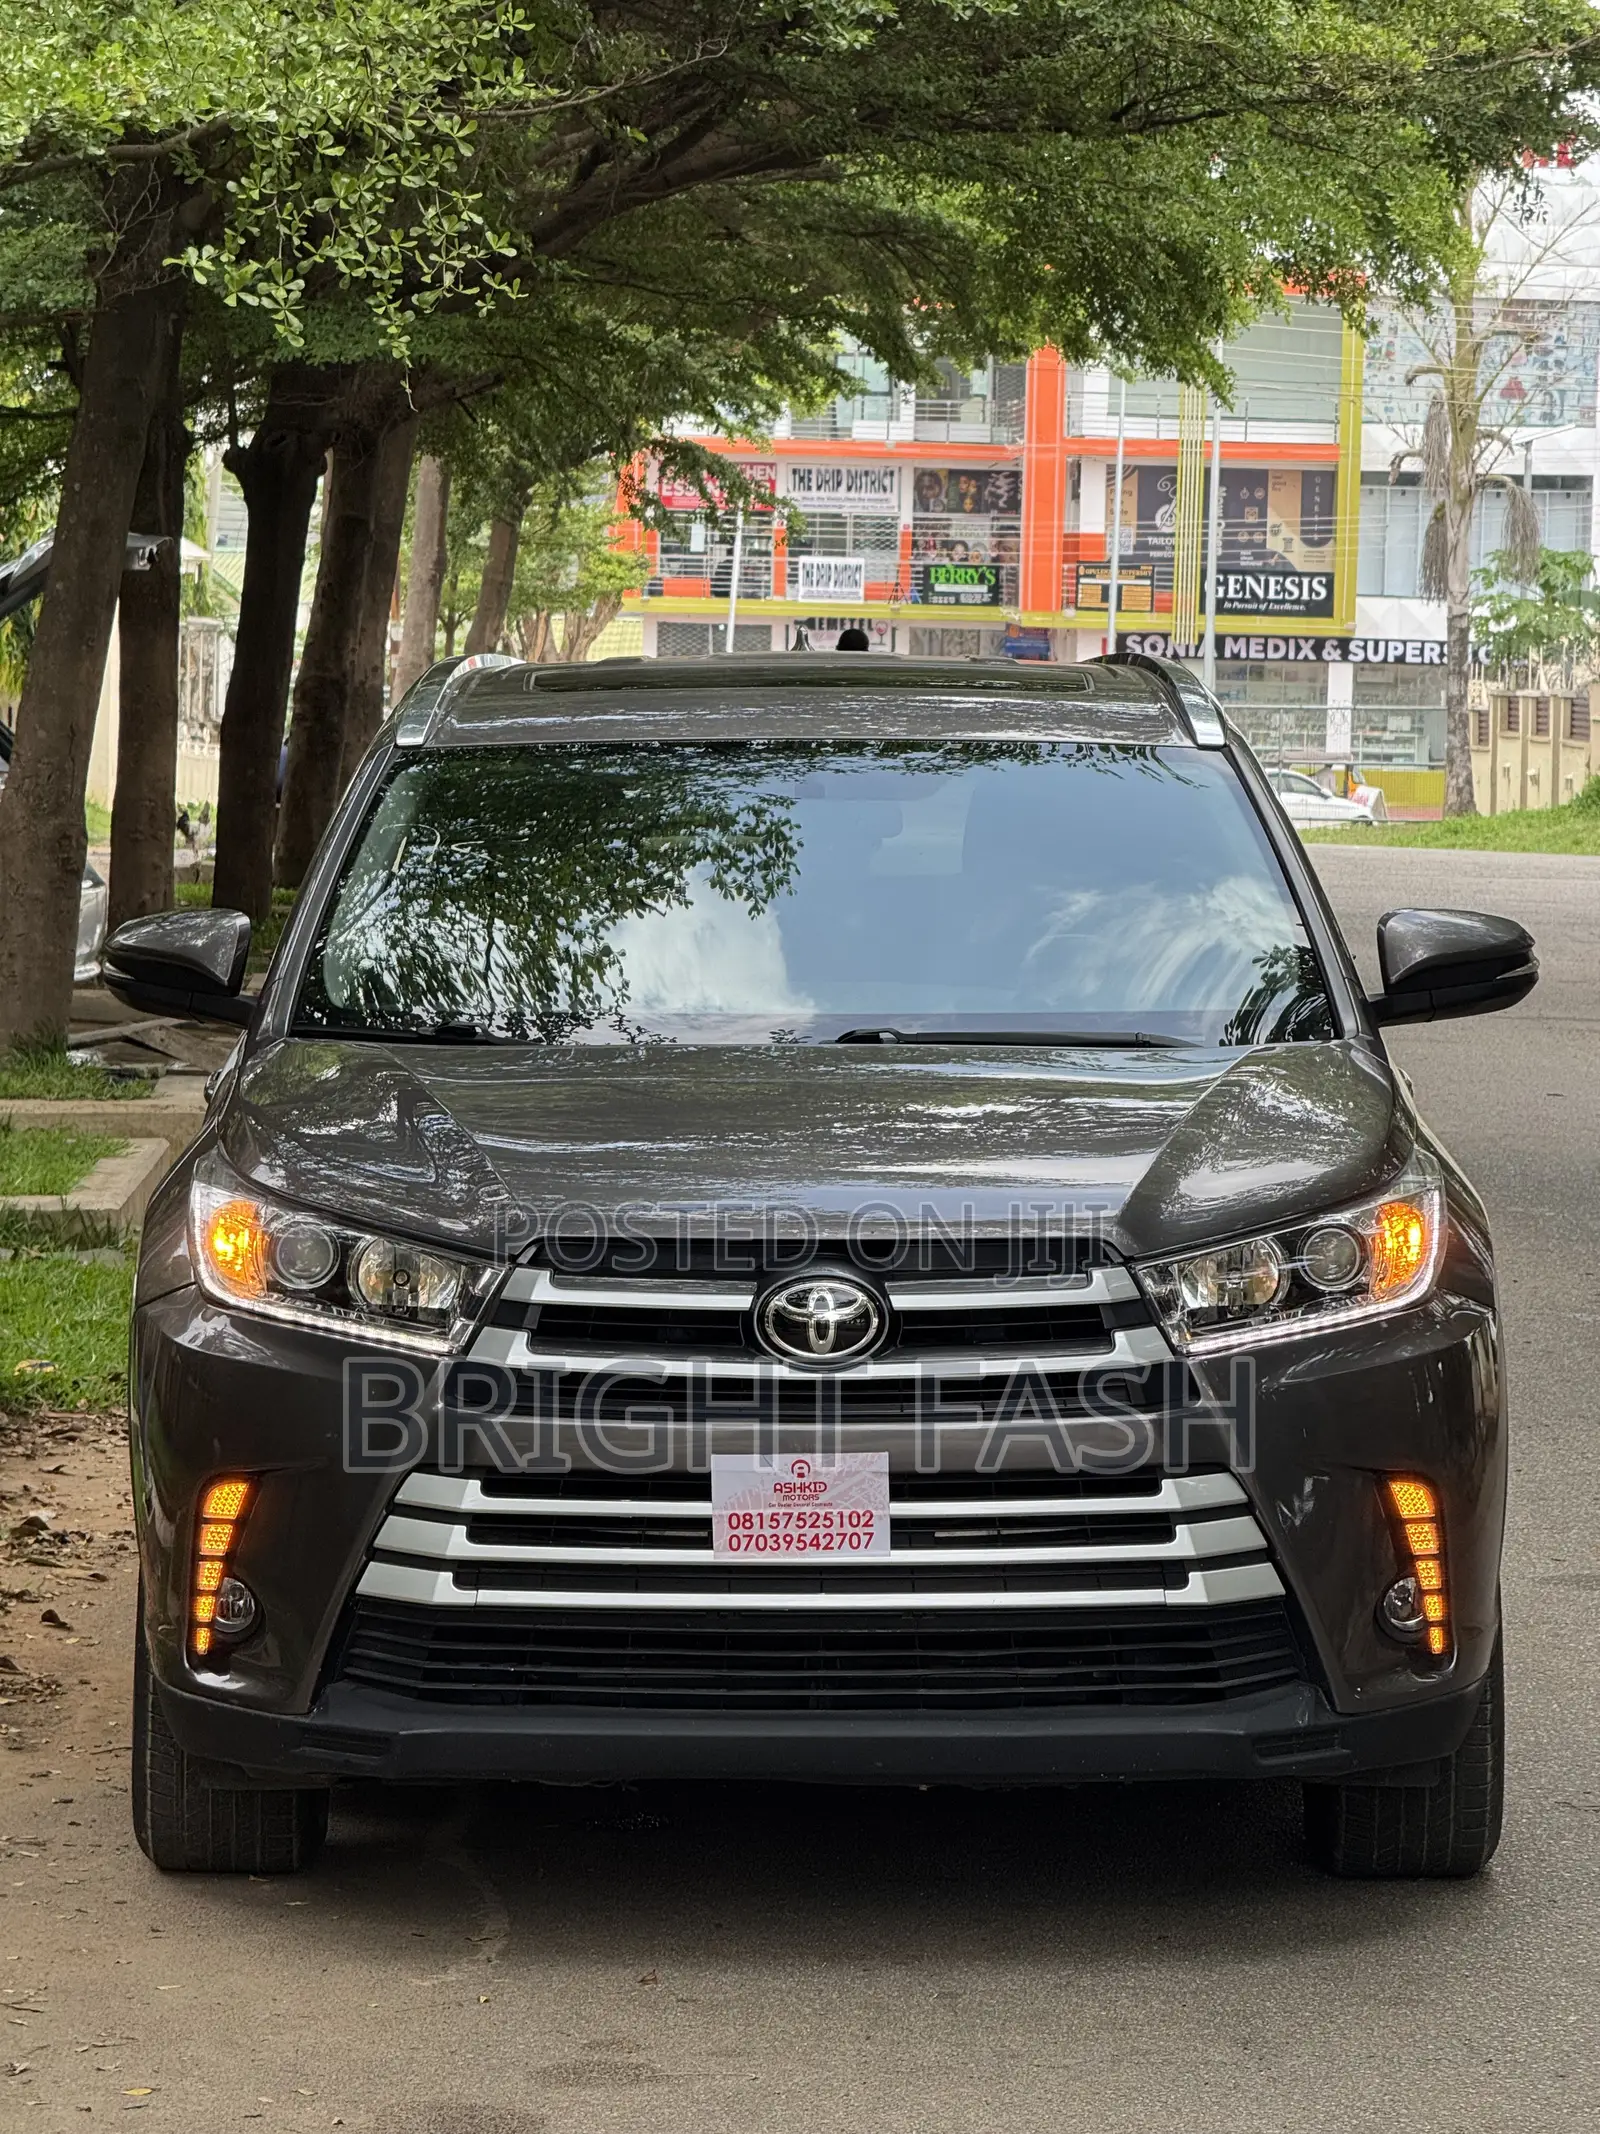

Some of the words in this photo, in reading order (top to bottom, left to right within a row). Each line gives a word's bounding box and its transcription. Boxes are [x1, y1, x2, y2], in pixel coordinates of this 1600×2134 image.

[792, 468, 813, 492] THE
[816, 468, 842, 492] DRIP
[846, 469, 895, 493] DISTRICT
[802, 563, 814, 587] THE
[816, 563, 832, 587] DRIP
[834, 564, 862, 588] DISTRICT
[929, 565, 996, 585] BERRY'S
[1204, 574, 1328, 600] GENESIS
[1223, 601, 1232, 609] In
[1232, 601, 1258, 610] Pursuit
[1259, 602, 1268, 611] of
[1224, 636, 1317, 660] MEDIX
[1322, 639, 1342, 661] &
[773, 1481, 827, 1493] ASHKID
[728, 1510, 875, 1530] 08157525102
[728, 1532, 875, 1552] 07039542707
